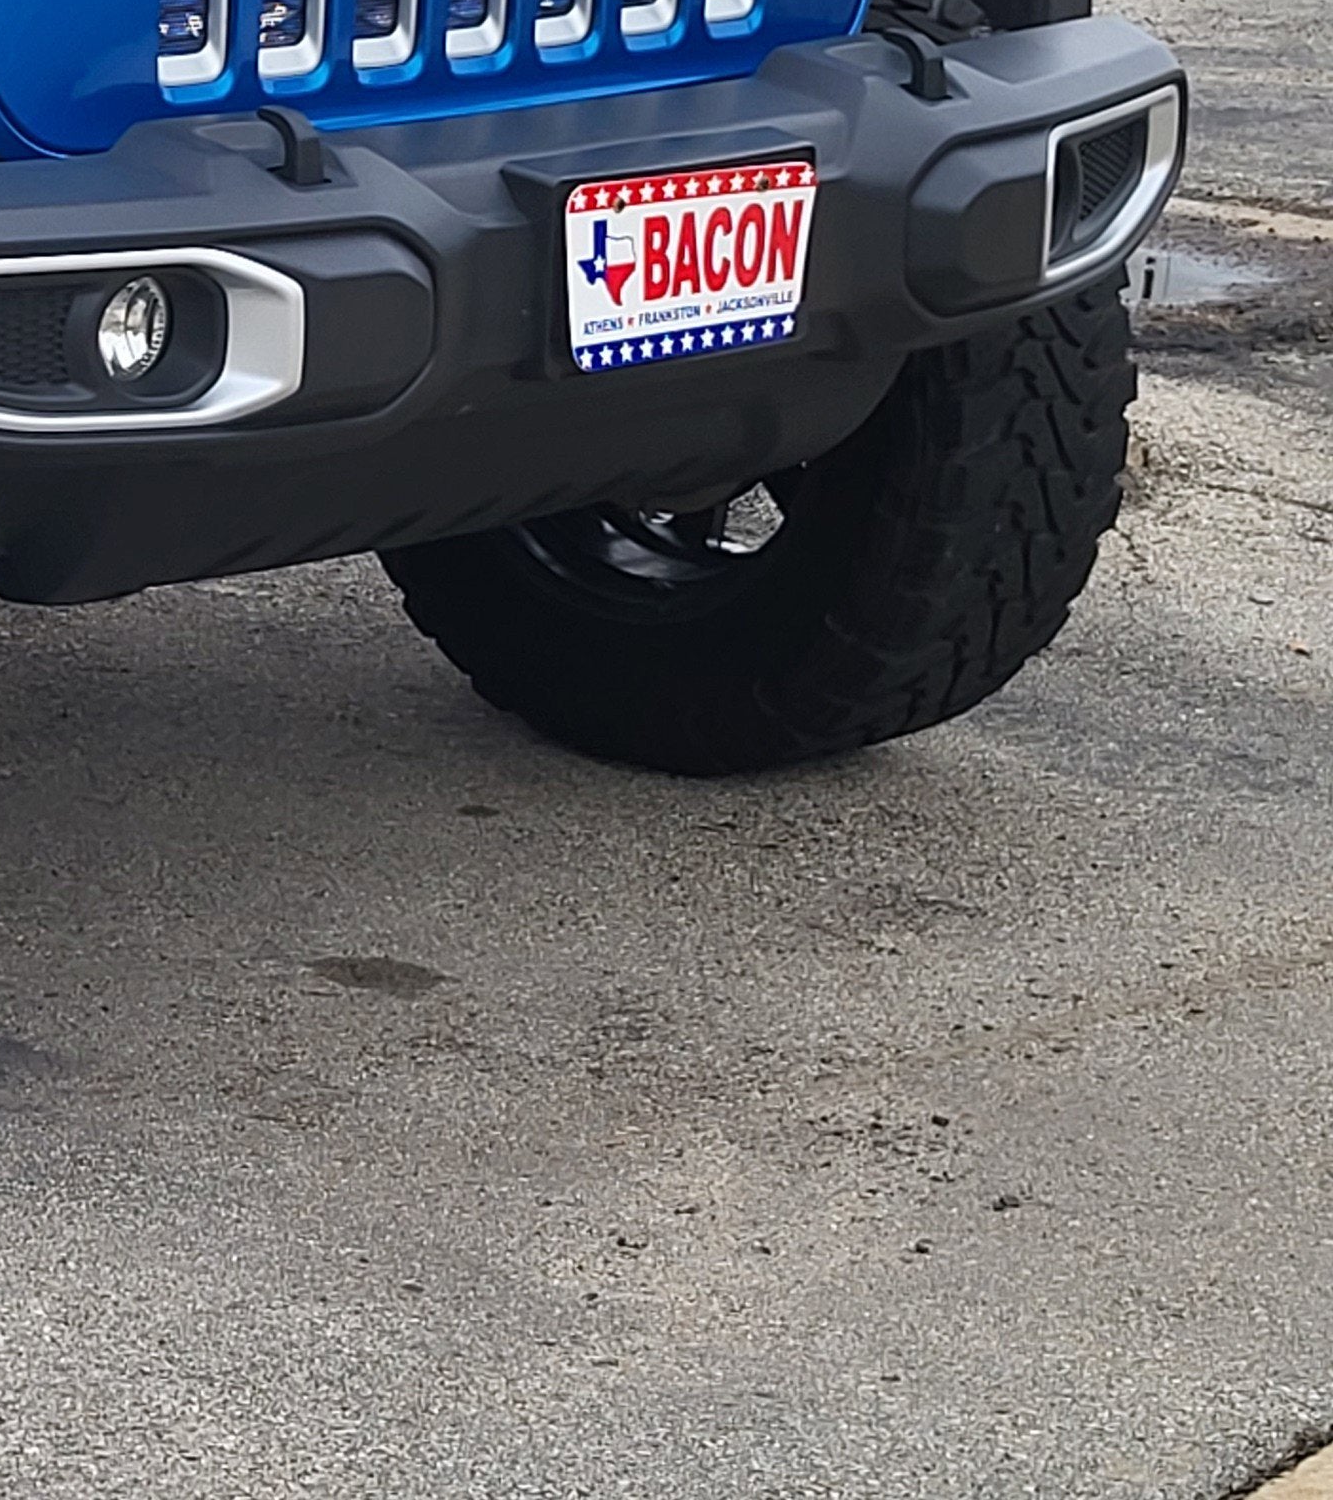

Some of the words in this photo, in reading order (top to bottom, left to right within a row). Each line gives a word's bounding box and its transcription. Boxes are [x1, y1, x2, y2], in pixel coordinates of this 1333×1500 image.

[643, 199, 804, 301] BACON
[583, 316, 624, 335] ATHENS
[638, 304, 701, 327] FRANKSTON
[716, 290, 793, 315] JACKSONVILLE
